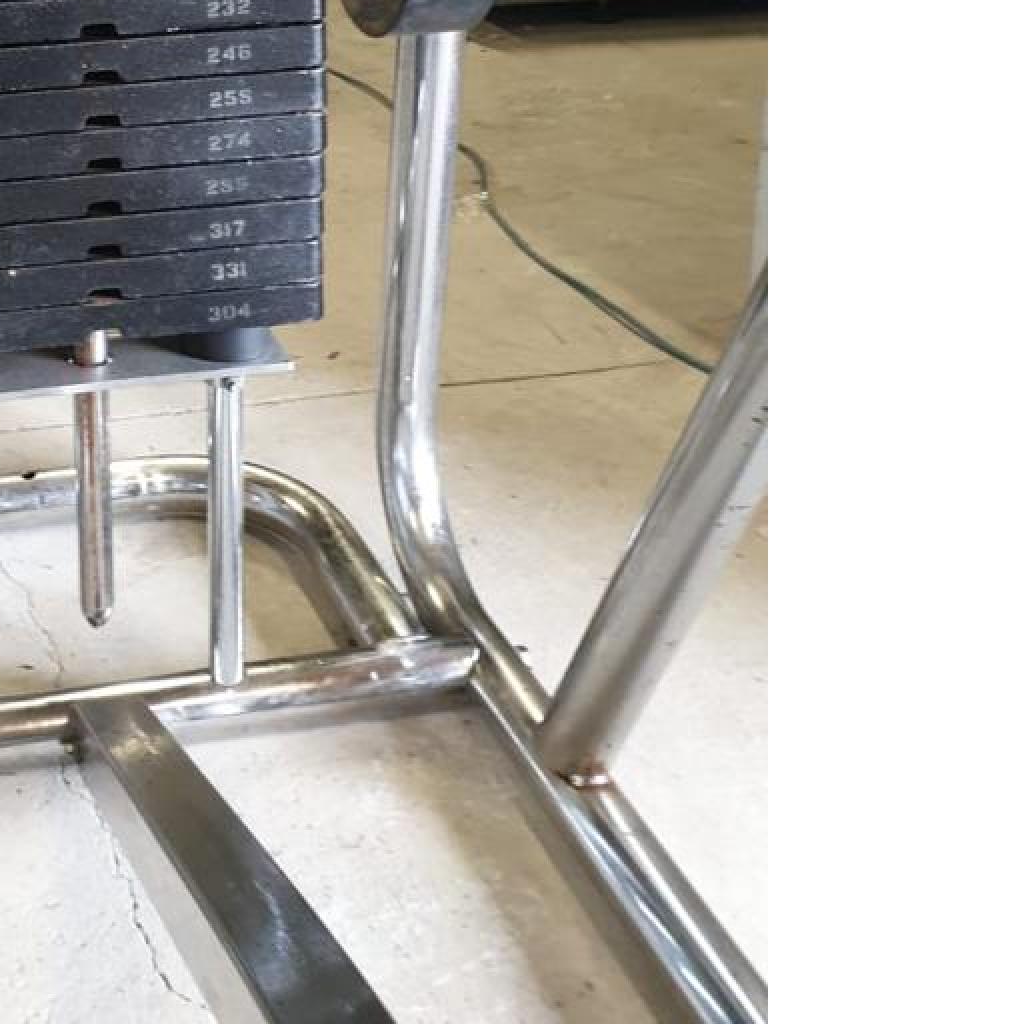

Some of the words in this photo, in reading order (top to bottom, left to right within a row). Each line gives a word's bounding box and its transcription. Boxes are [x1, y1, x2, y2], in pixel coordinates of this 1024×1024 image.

[208, 44, 252, 63] 246
[208, 132, 251, 151] 274
[209, 220, 245, 239] 317
[211, 262, 247, 281] 331
